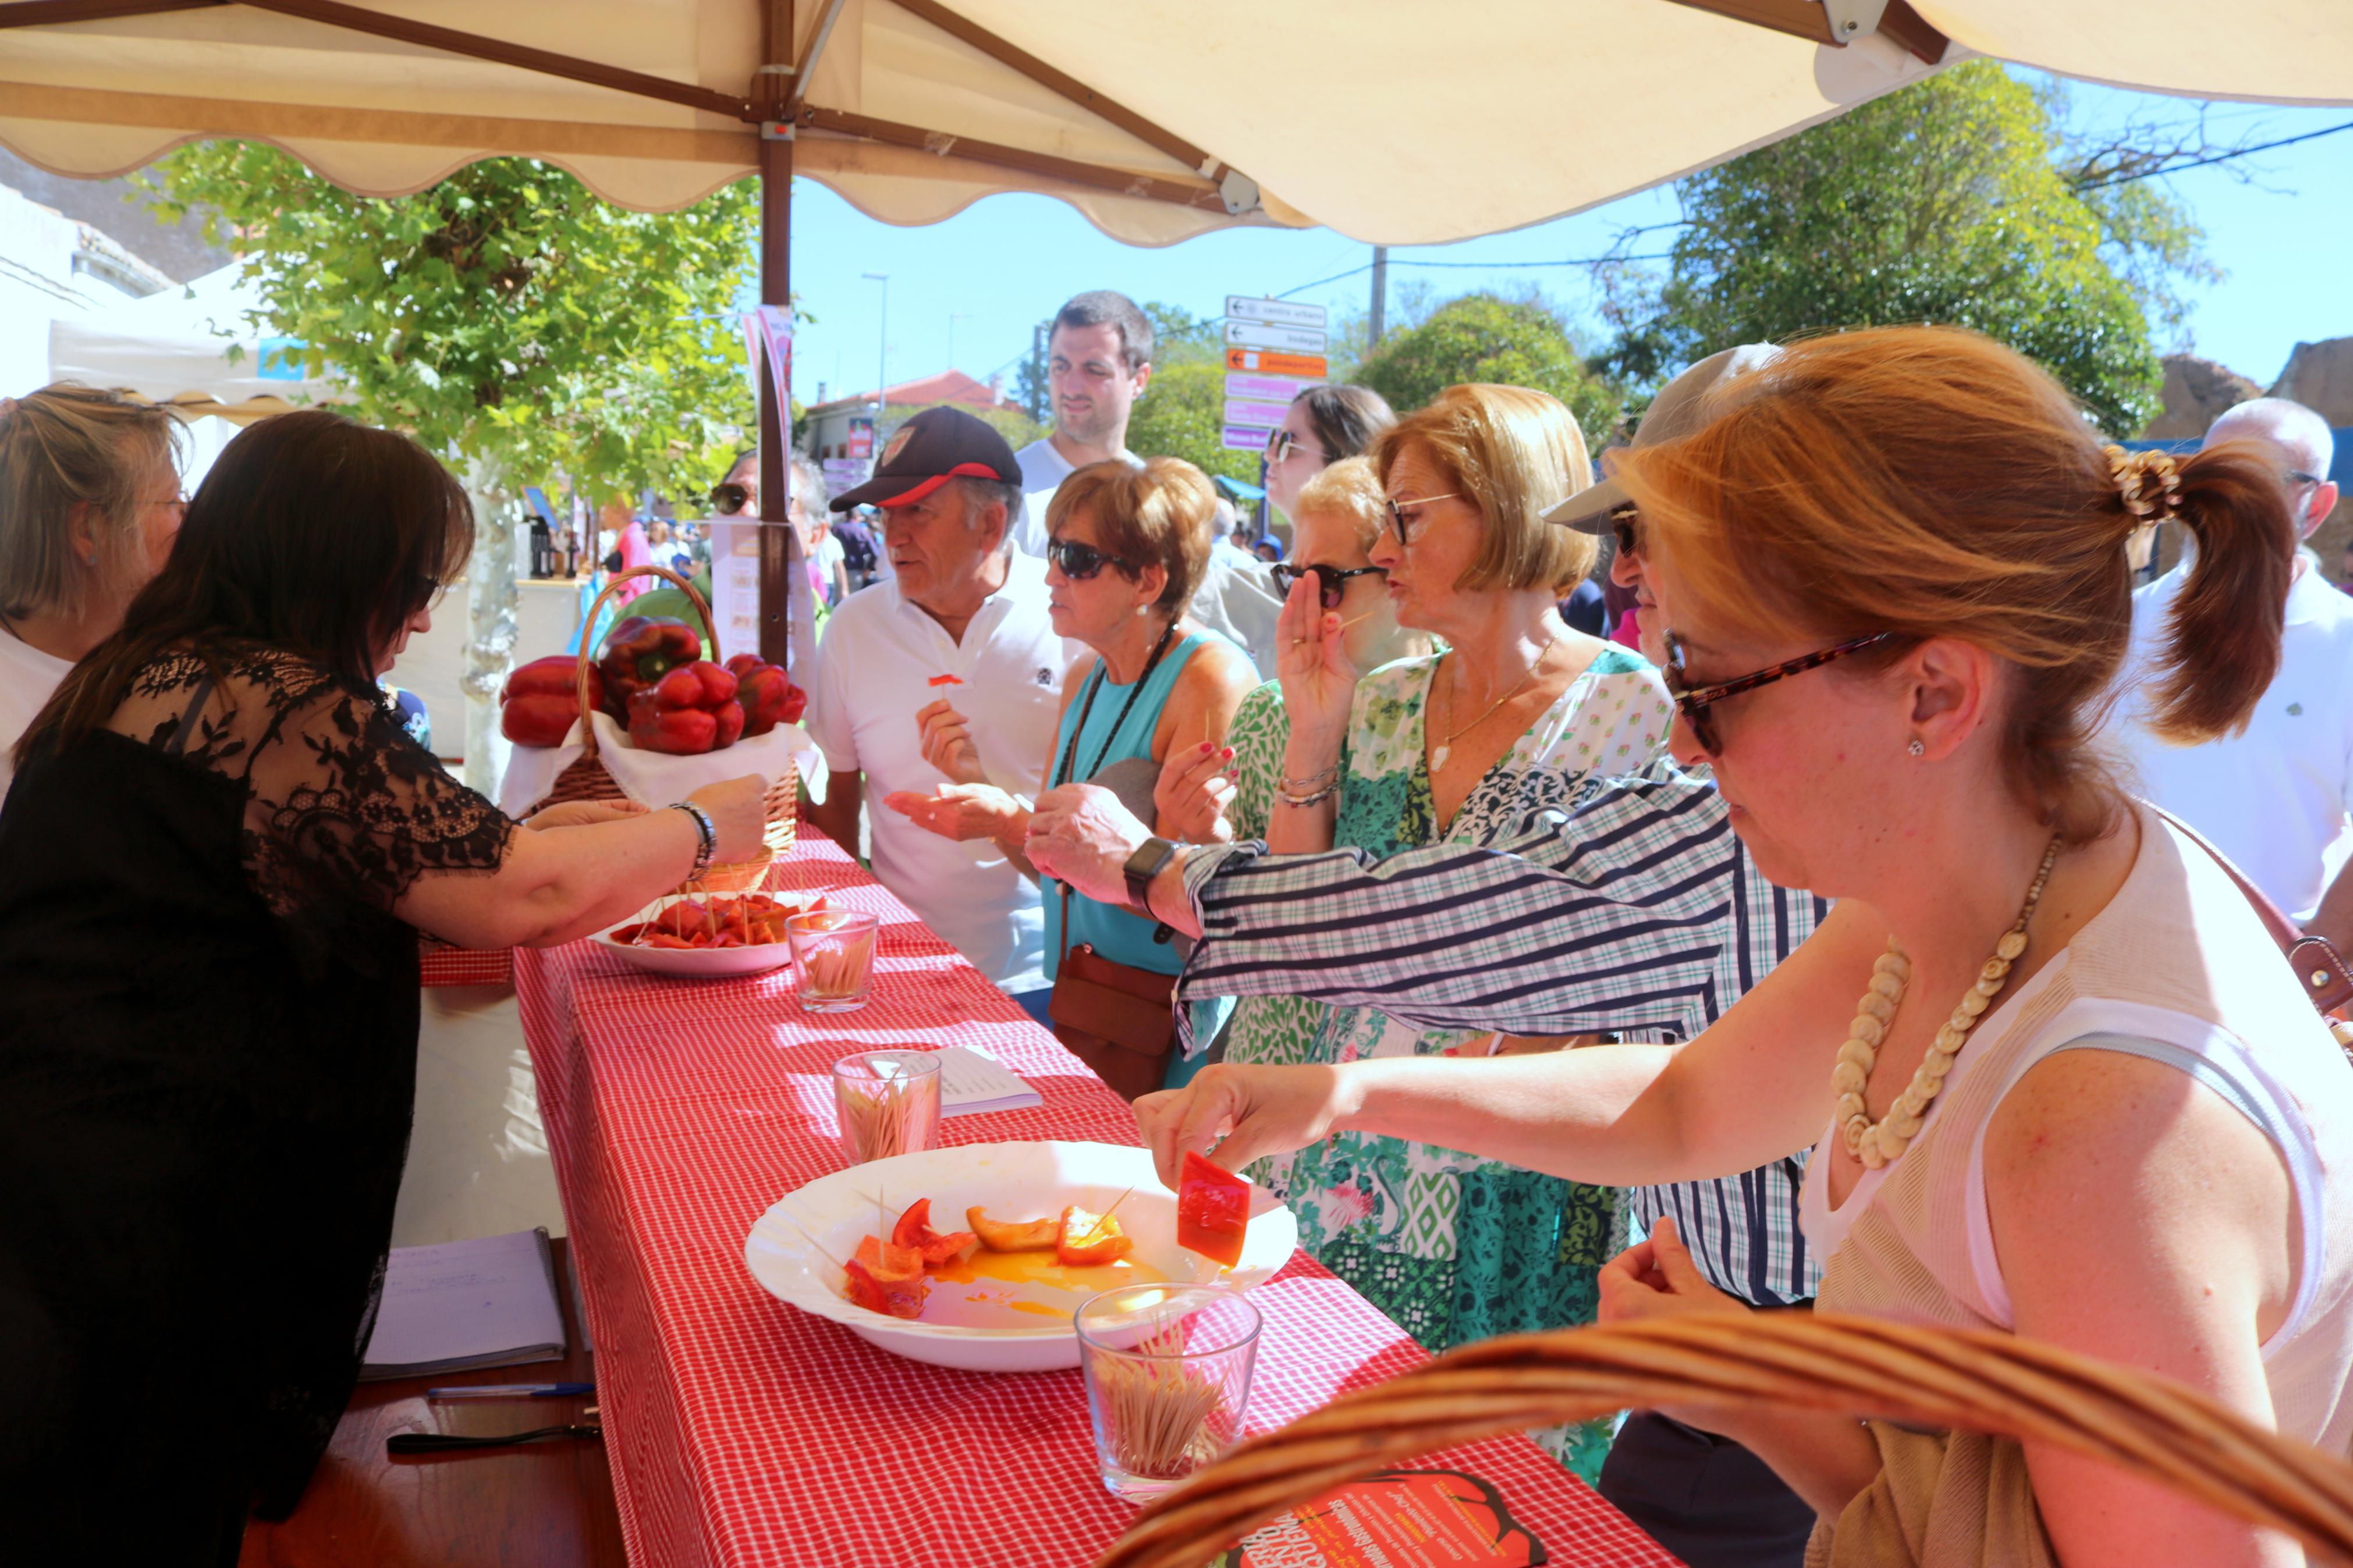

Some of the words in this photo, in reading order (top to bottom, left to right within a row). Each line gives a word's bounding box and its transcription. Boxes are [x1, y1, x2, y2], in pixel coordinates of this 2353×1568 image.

[1262, 305, 1290, 317] centro
[1294, 309, 1323, 320] urbano
[1287, 335, 1323, 346] bodegas
[1266, 358, 1323, 371] polideportivo
[1327, 1499, 1375, 1548] Gastronómicas
[1273, 1509, 1328, 1568] QUEMA
[1436, 1537, 1464, 1561] Concurso
